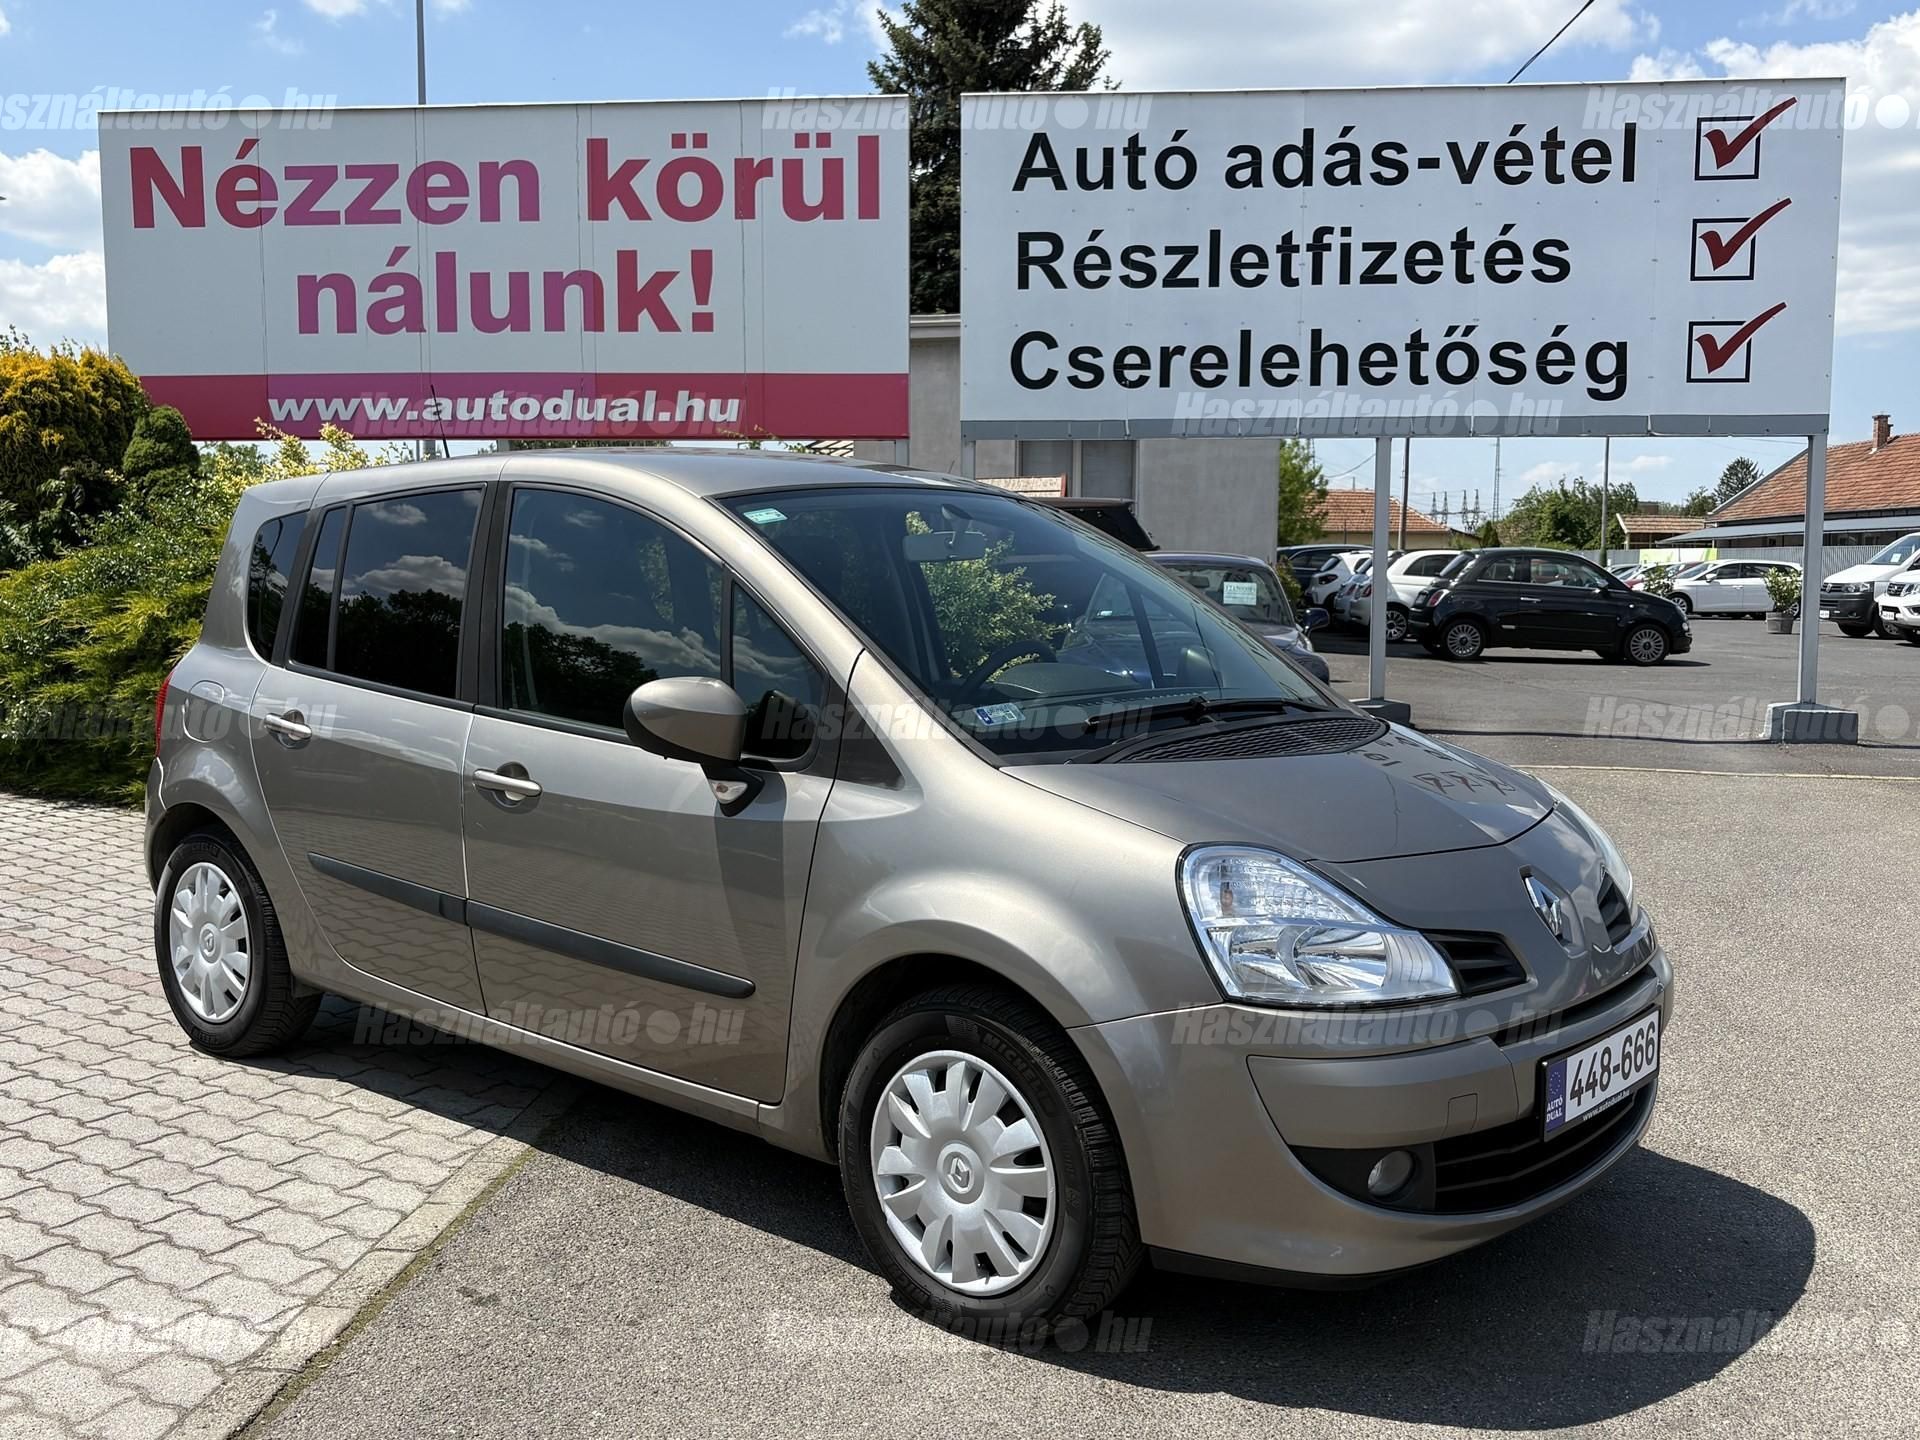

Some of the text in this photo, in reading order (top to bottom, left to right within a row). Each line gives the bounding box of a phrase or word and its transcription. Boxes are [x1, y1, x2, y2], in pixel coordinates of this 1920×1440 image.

[130, 132, 880, 229] Nézzen körül
[1012, 121, 1637, 192] Autó adás-vétel
[297, 246, 714, 335] nálunk!
[1017, 223, 1572, 291] Részletfizetés
[1010, 323, 1630, 402] Cserelehetőség
[268, 388, 740, 424] www.autodual.hu
[1569, 1020, 1656, 1107] 448-666
[1546, 1108, 1563, 1123] DUAL
